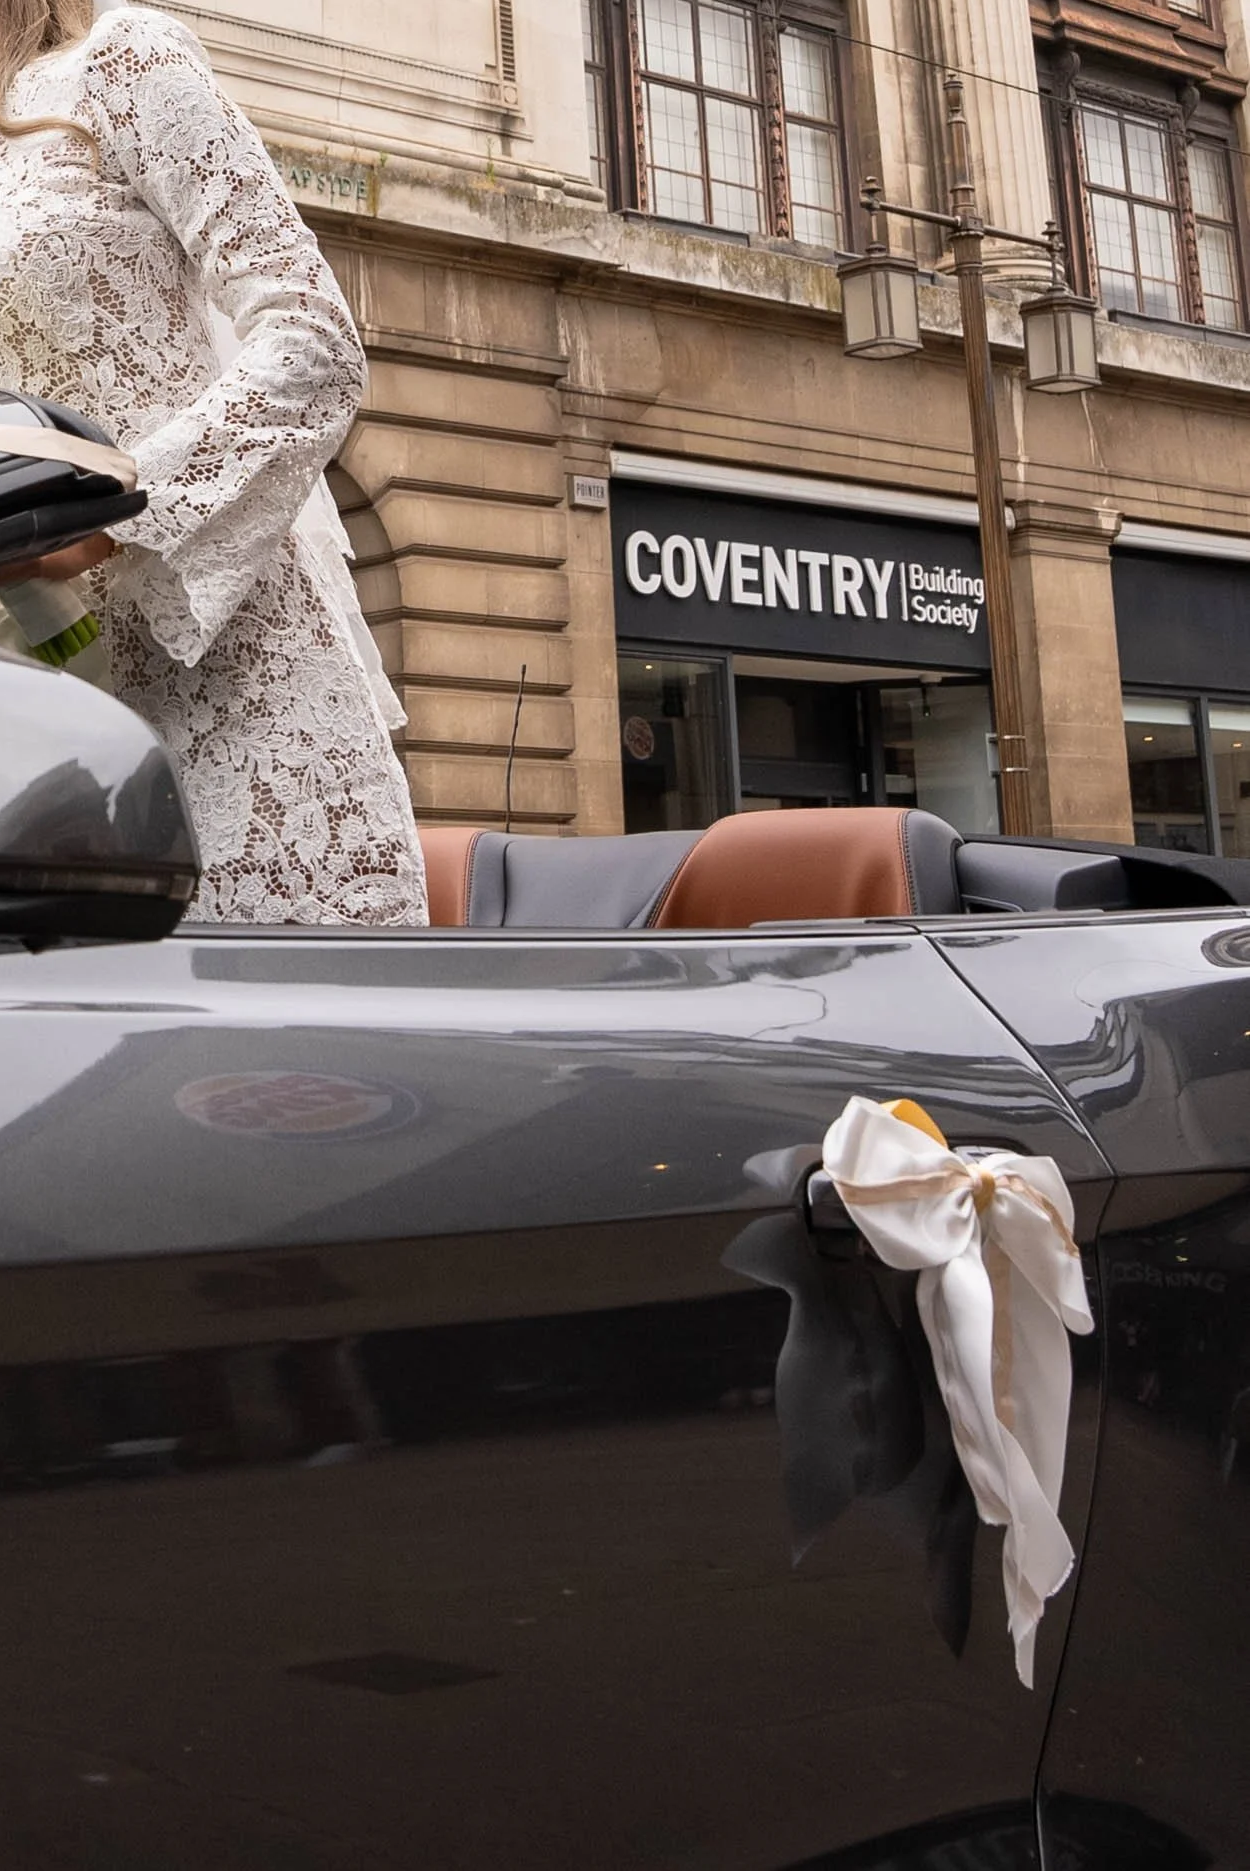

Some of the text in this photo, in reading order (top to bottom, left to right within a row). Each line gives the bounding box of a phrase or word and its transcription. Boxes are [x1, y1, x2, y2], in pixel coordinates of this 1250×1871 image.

[625, 530, 895, 619] COVENTRY
[909, 563, 984, 604] Building
[911, 595, 978, 634] Society
